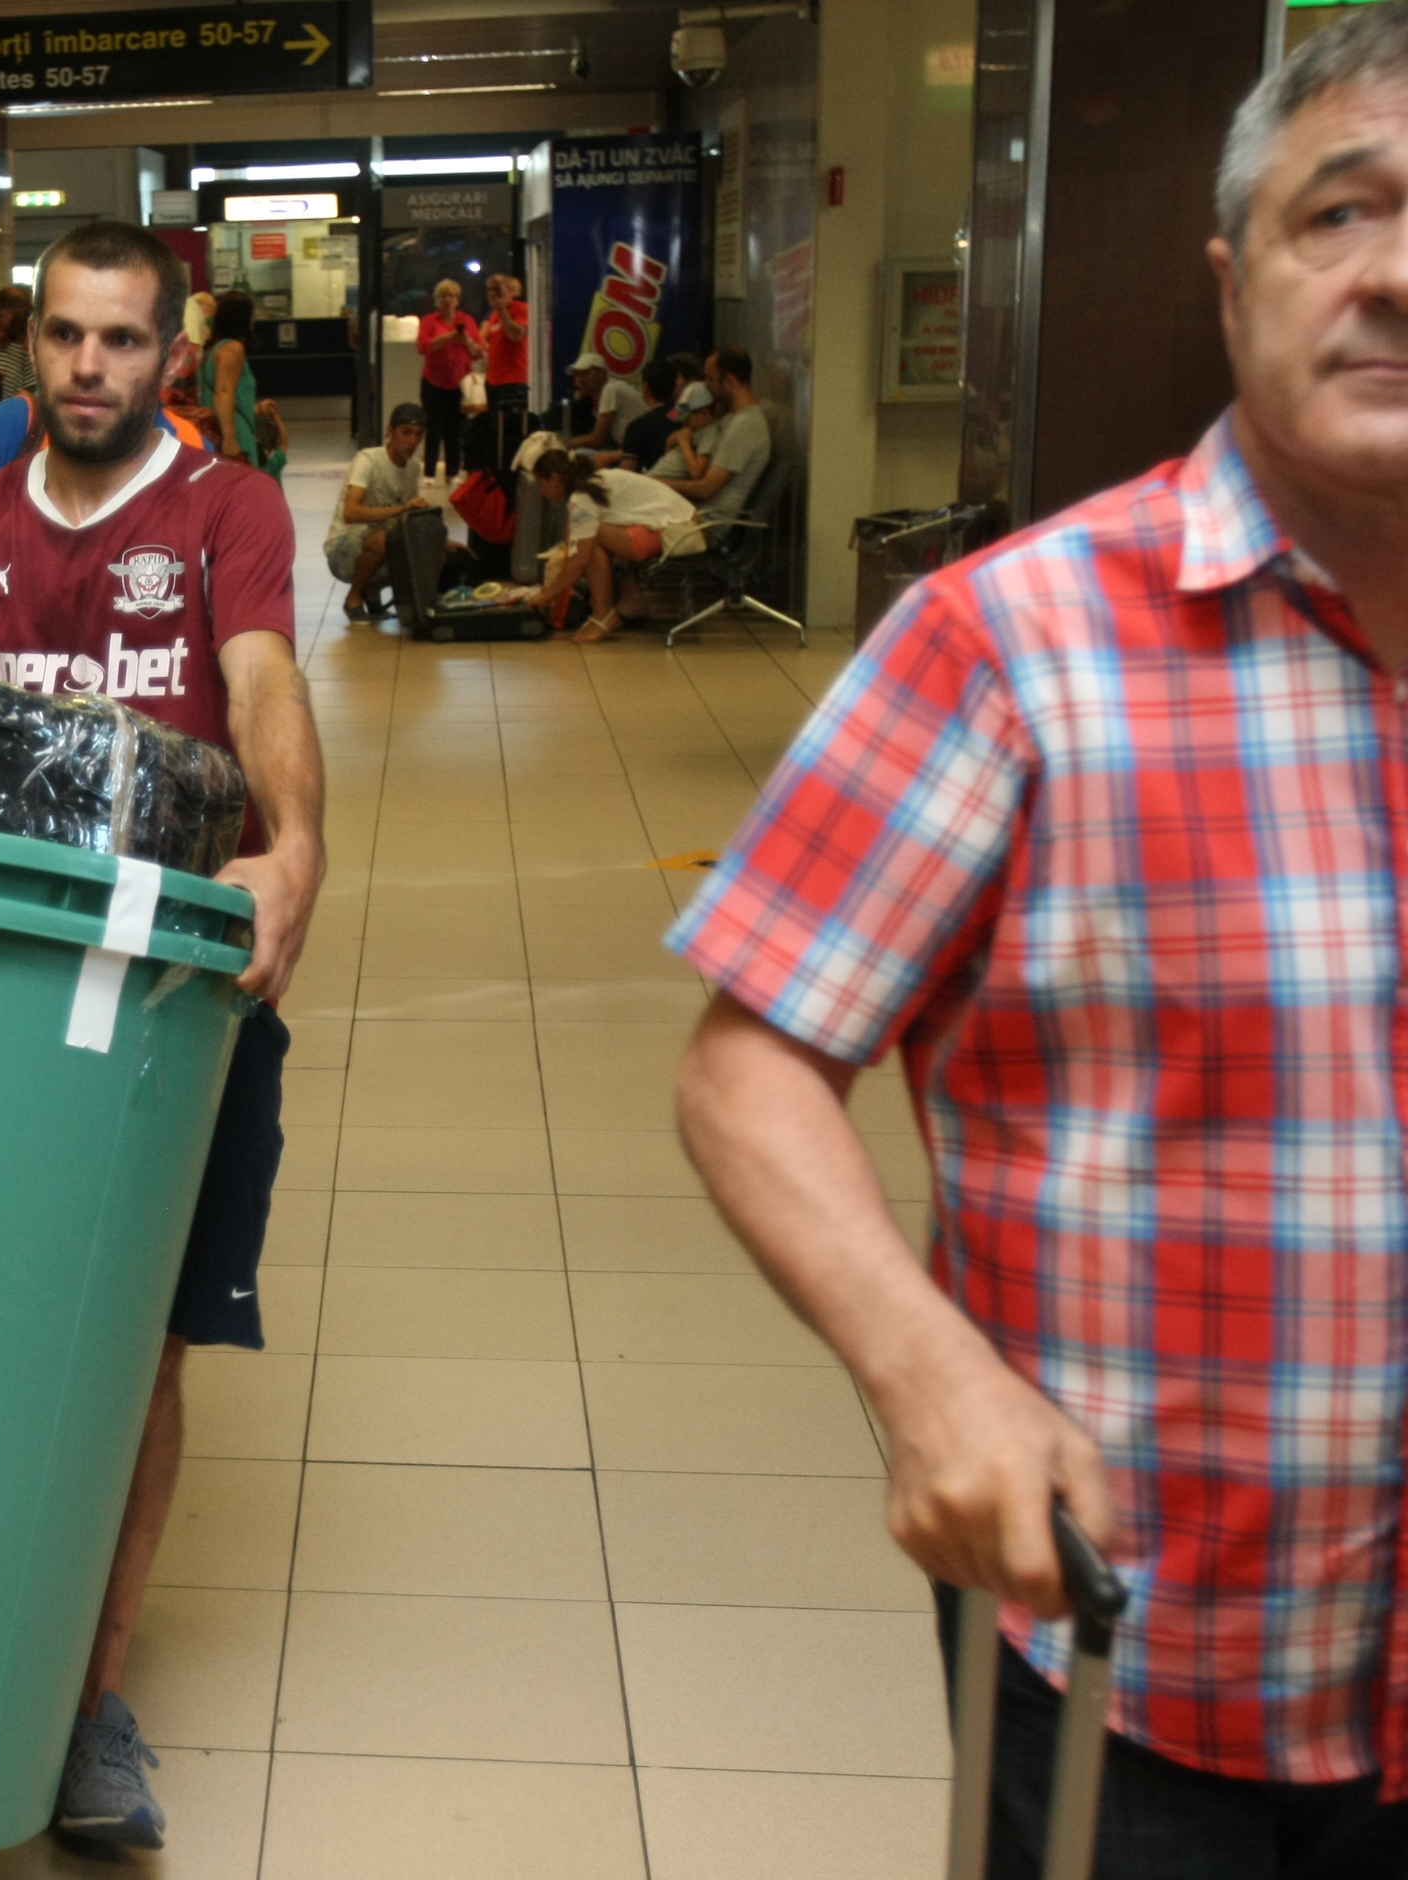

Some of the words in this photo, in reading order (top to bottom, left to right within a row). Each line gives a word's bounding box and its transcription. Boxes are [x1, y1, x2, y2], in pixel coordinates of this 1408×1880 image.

[43, 28, 187, 54] îmbarcare
[200, 19, 277, 46] 50-57
[45, 65, 110, 88] 50-57
[610, 148, 640, 167] UN
[410, 206, 484, 221] MEDICALE
[593, 241, 668, 379] OM
[133, 554, 165, 565] RAPID
